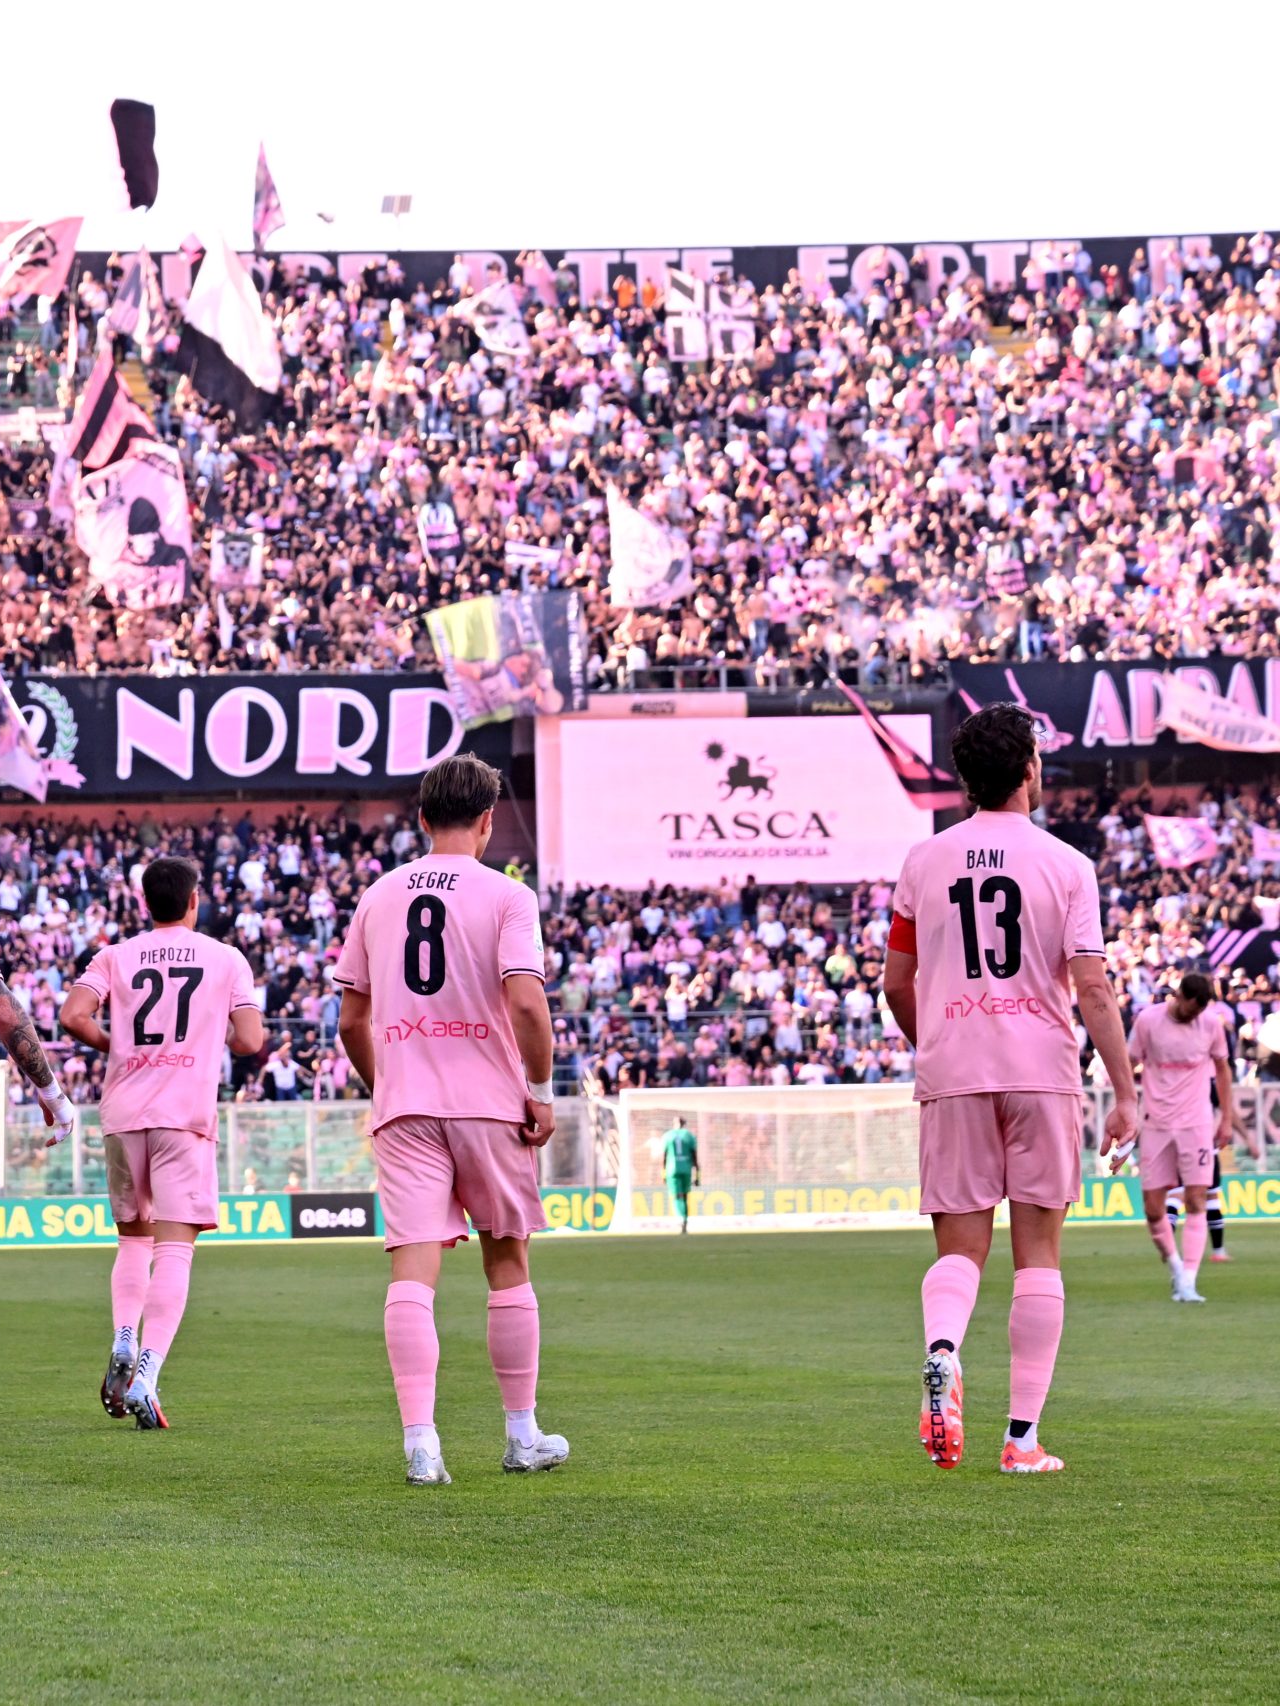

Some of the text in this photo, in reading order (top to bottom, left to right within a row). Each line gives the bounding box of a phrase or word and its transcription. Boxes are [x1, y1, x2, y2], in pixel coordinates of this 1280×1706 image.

[115, 684, 467, 780] NORD
[658, 811, 832, 841] TASCA
[966, 849, 1005, 869] BANI
[407, 871, 460, 891] SEGRE
[404, 893, 447, 996] 8
[948, 875, 1022, 980] 13
[140, 947, 196, 965] PIEROZZI
[131, 966, 204, 1046] 27
[41, 1204, 118, 1237] SOL
[215, 1201, 286, 1234] LTA
[542, 1192, 615, 1229] GIO
